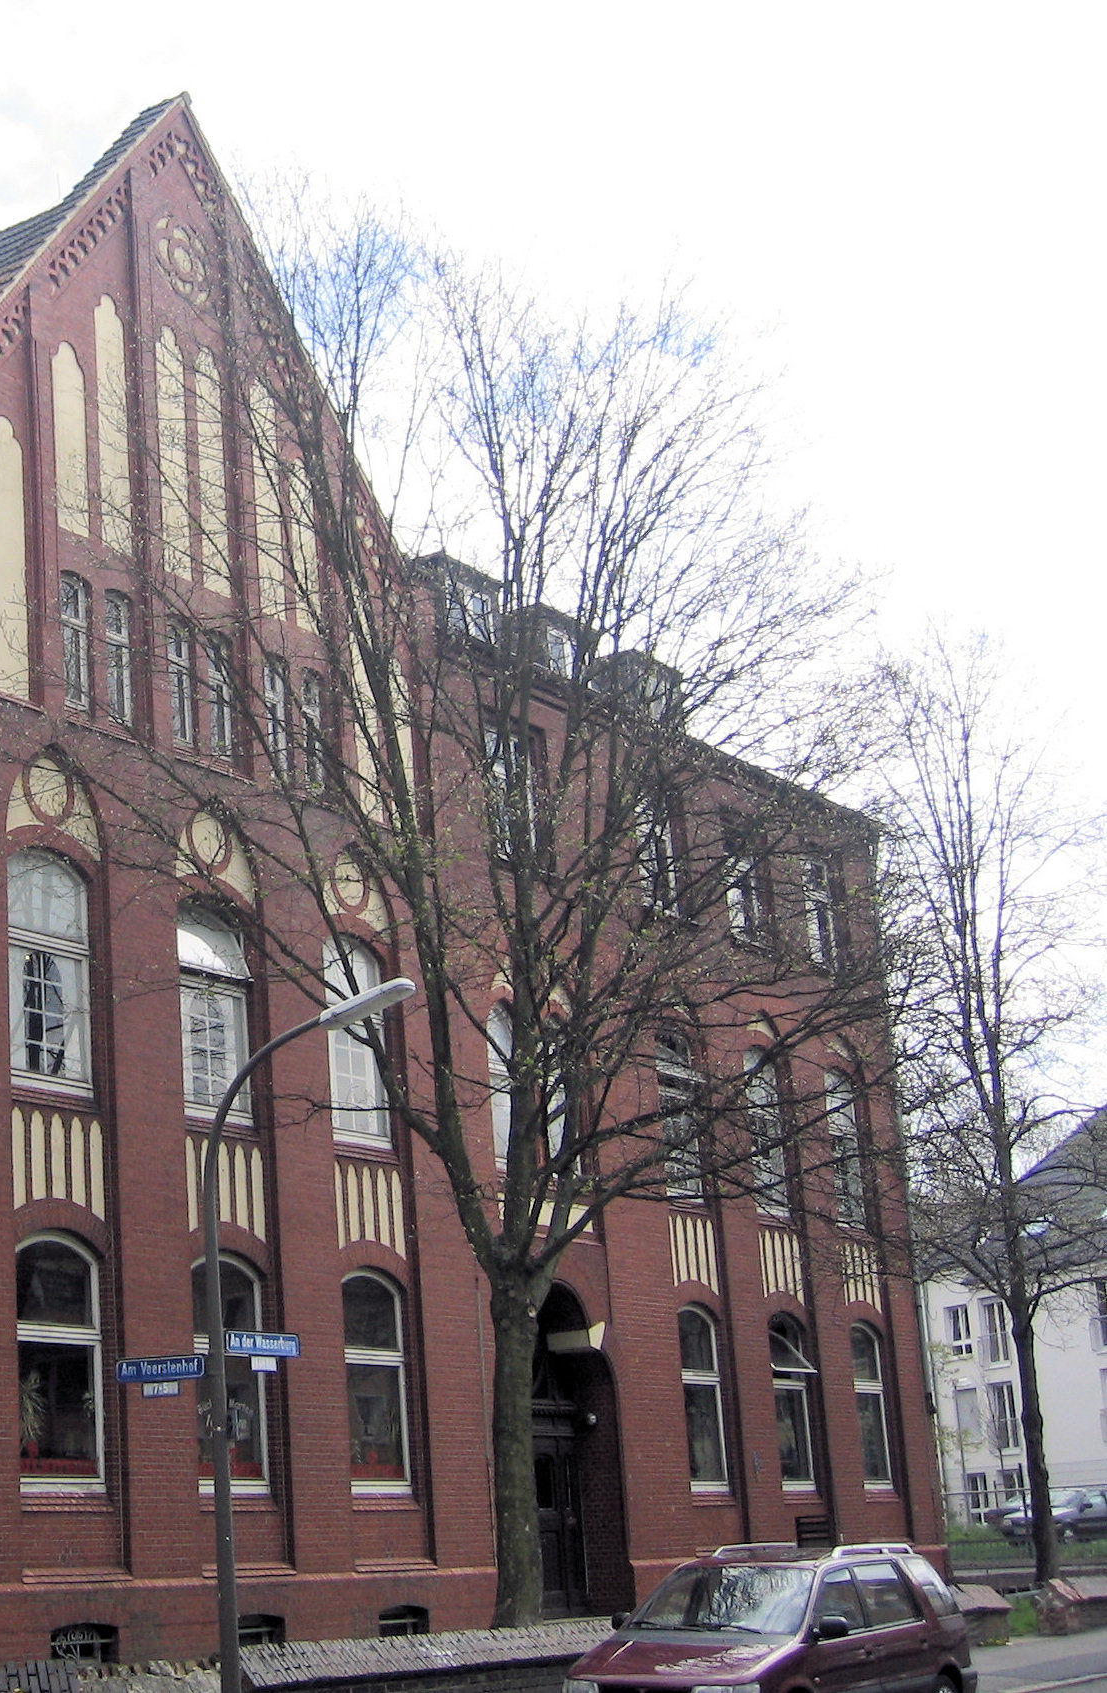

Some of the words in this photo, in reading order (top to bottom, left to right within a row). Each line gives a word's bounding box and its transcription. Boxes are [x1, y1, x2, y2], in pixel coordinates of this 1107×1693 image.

[230, 1333, 240, 1347] An
[241, 1334, 254, 1348] der
[255, 1335, 296, 1354] Wasserburg
[121, 1362, 137, 1376] Am
[140, 1358, 198, 1375] Voerstenhof
